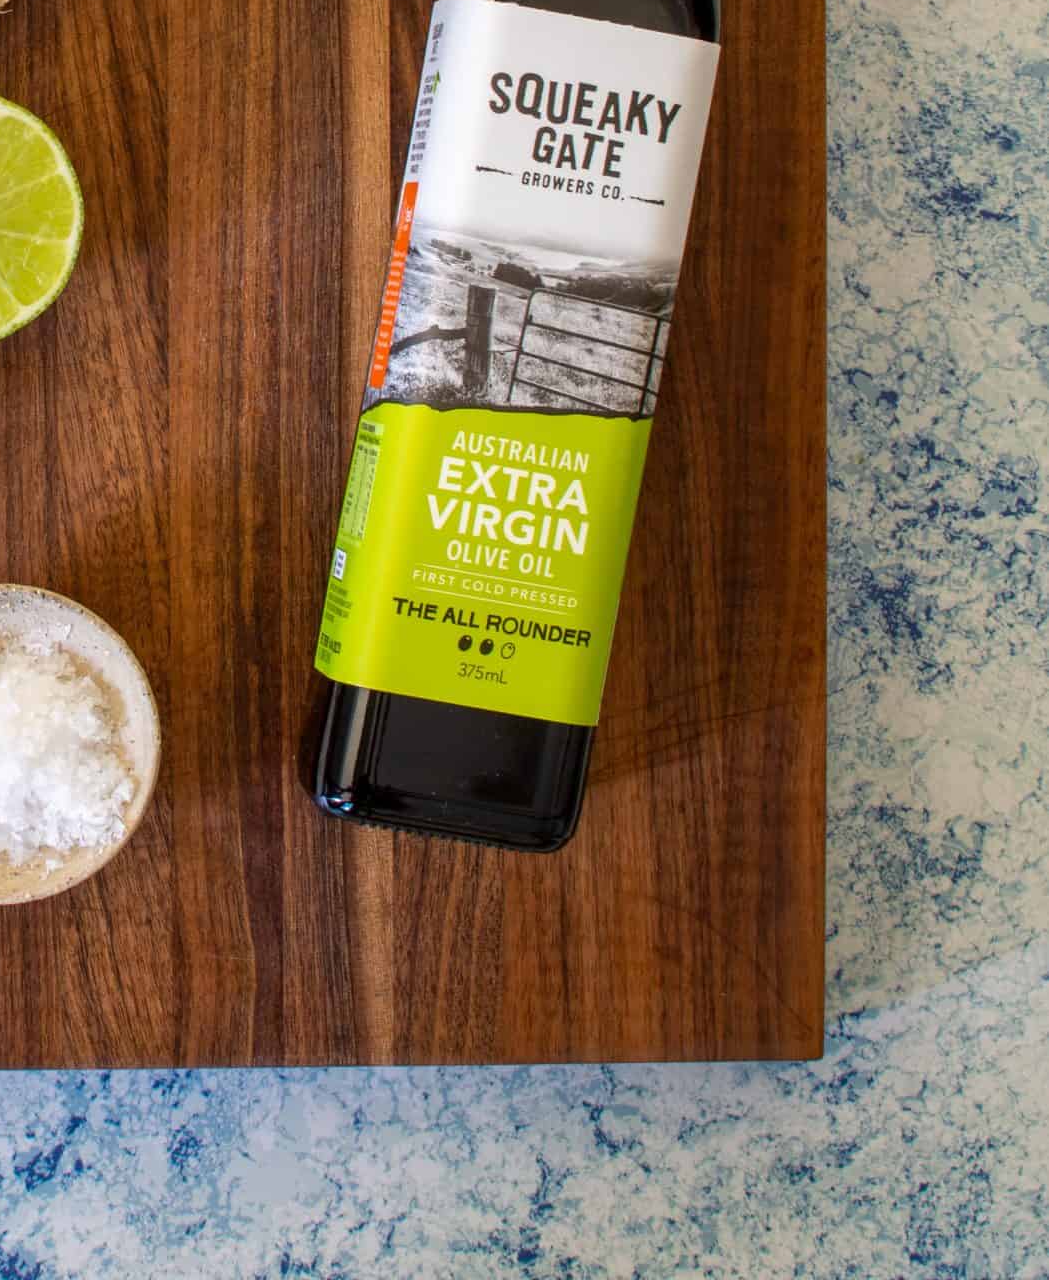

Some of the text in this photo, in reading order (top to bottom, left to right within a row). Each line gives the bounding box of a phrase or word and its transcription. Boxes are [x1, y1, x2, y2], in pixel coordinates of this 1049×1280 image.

[488, 72, 682, 144] SQUEAKY
[532, 126, 625, 178] GATE
[521, 171, 625, 201] GROWERS CO.
[452, 430, 590, 473] AUSTRALIAN
[438, 455, 589, 515] EXTRA
[426, 494, 590, 555] VIRGIN
[446, 539, 555, 578] OLIVE OIL
[411, 569, 579, 609] FIRST COLD PRESSED
[392, 596, 592, 648] THE ALL ROUNDER
[457, 662, 509, 685] 375mL
